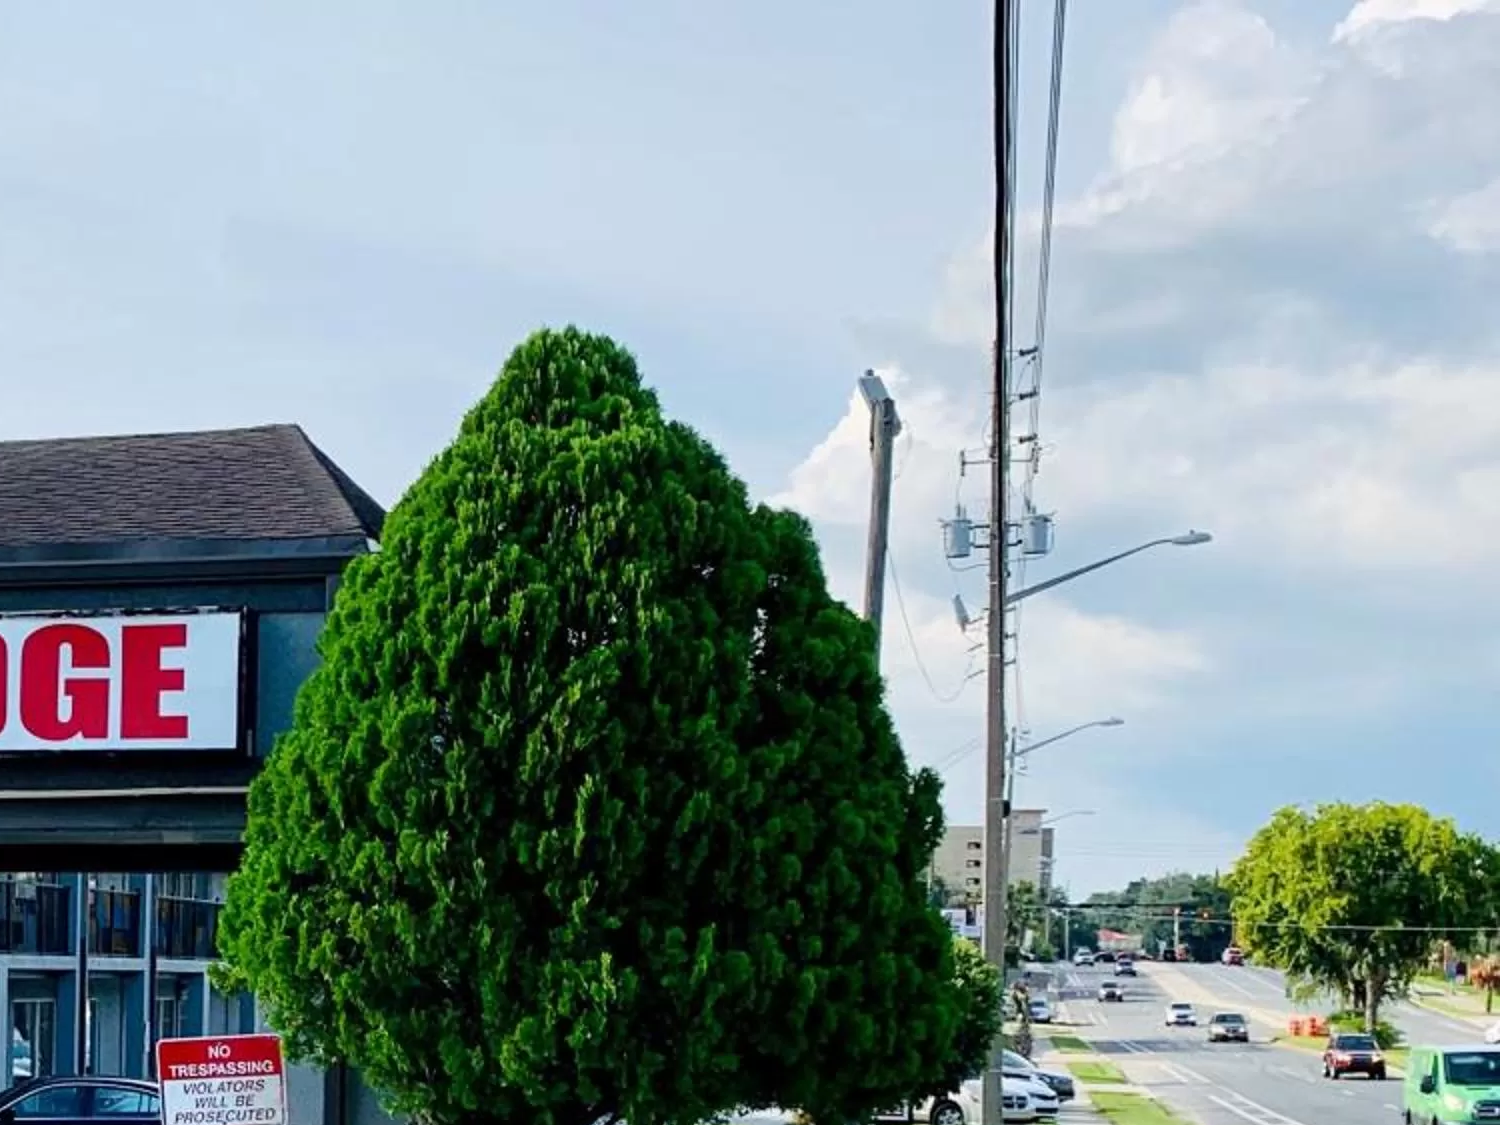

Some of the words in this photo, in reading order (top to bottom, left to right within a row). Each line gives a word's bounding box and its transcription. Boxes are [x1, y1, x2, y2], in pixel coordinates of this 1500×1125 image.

[207, 1045, 231, 1059] NO
[168, 1059, 274, 1078] TRESPASSING
[183, 1079, 265, 1095] VIOLATORS
[195, 1097, 228, 1109] WILL
[235, 1095, 254, 1107] BE
[175, 1107, 276, 1125] PROSECUTED
